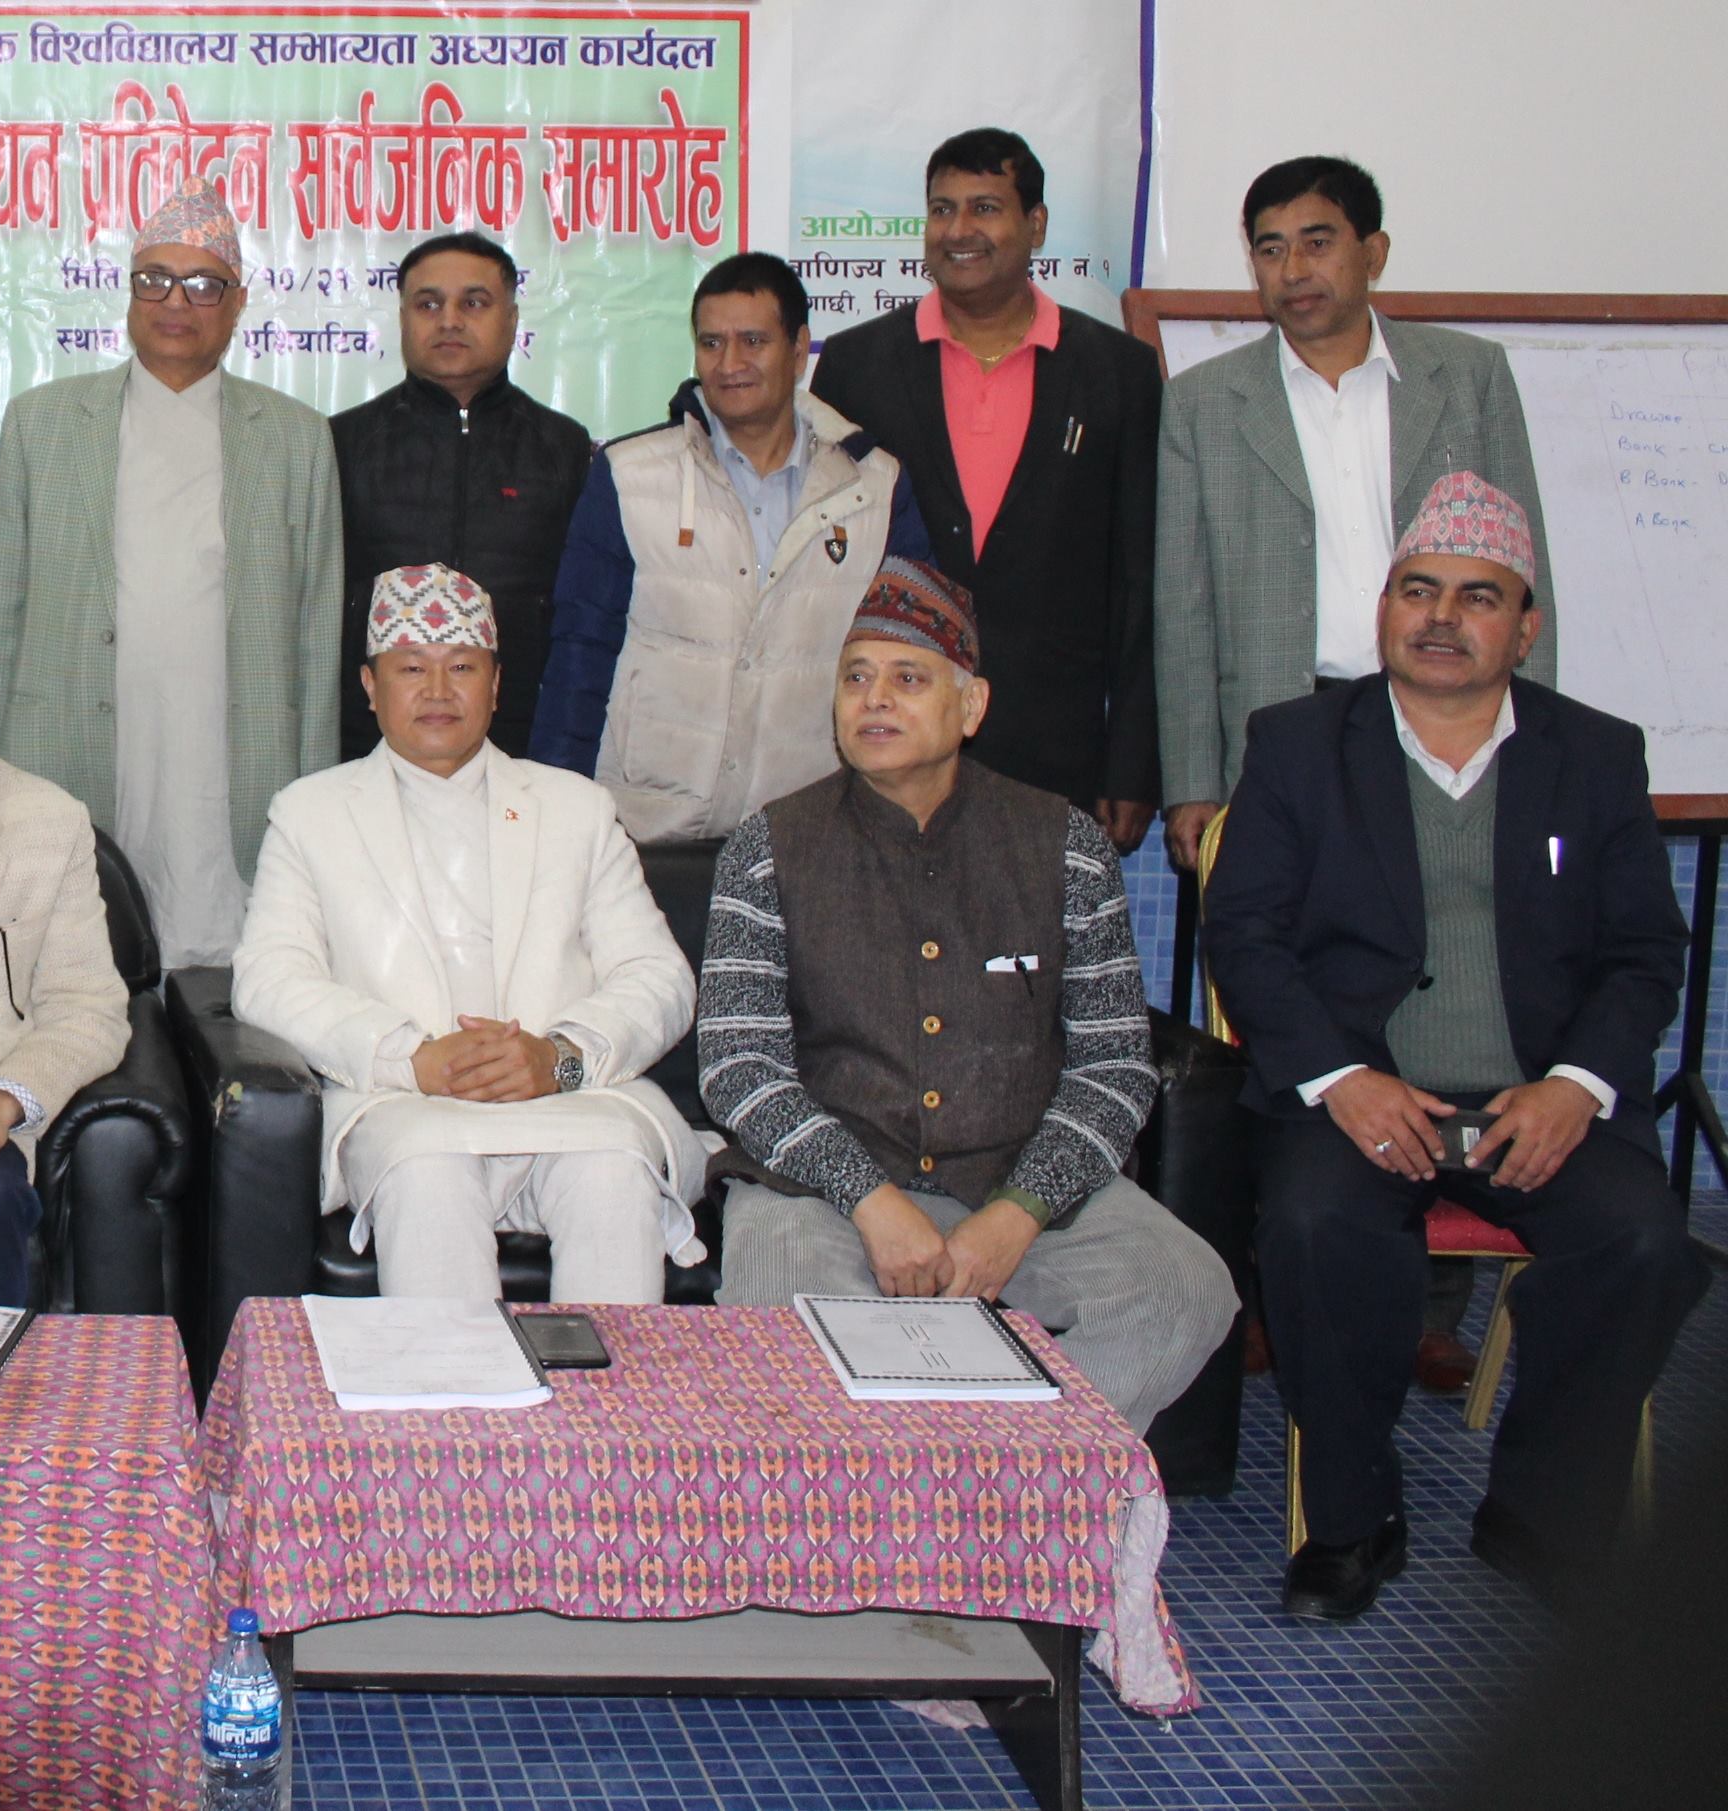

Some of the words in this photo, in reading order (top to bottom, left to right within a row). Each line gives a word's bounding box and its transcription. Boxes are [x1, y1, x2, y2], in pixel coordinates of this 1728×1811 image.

[30, 21, 238, 66] विश्वविद्यालय
[249, 32, 418, 66] सम्भाव्यता
[429, 34, 568, 66] अध्ययन
[580, 28, 716, 70] कार्यदल
[287, 82, 527, 240] सार्वजनिक
[542, 88, 727, 247] समारोह
[61, 257, 122, 290] मिति
